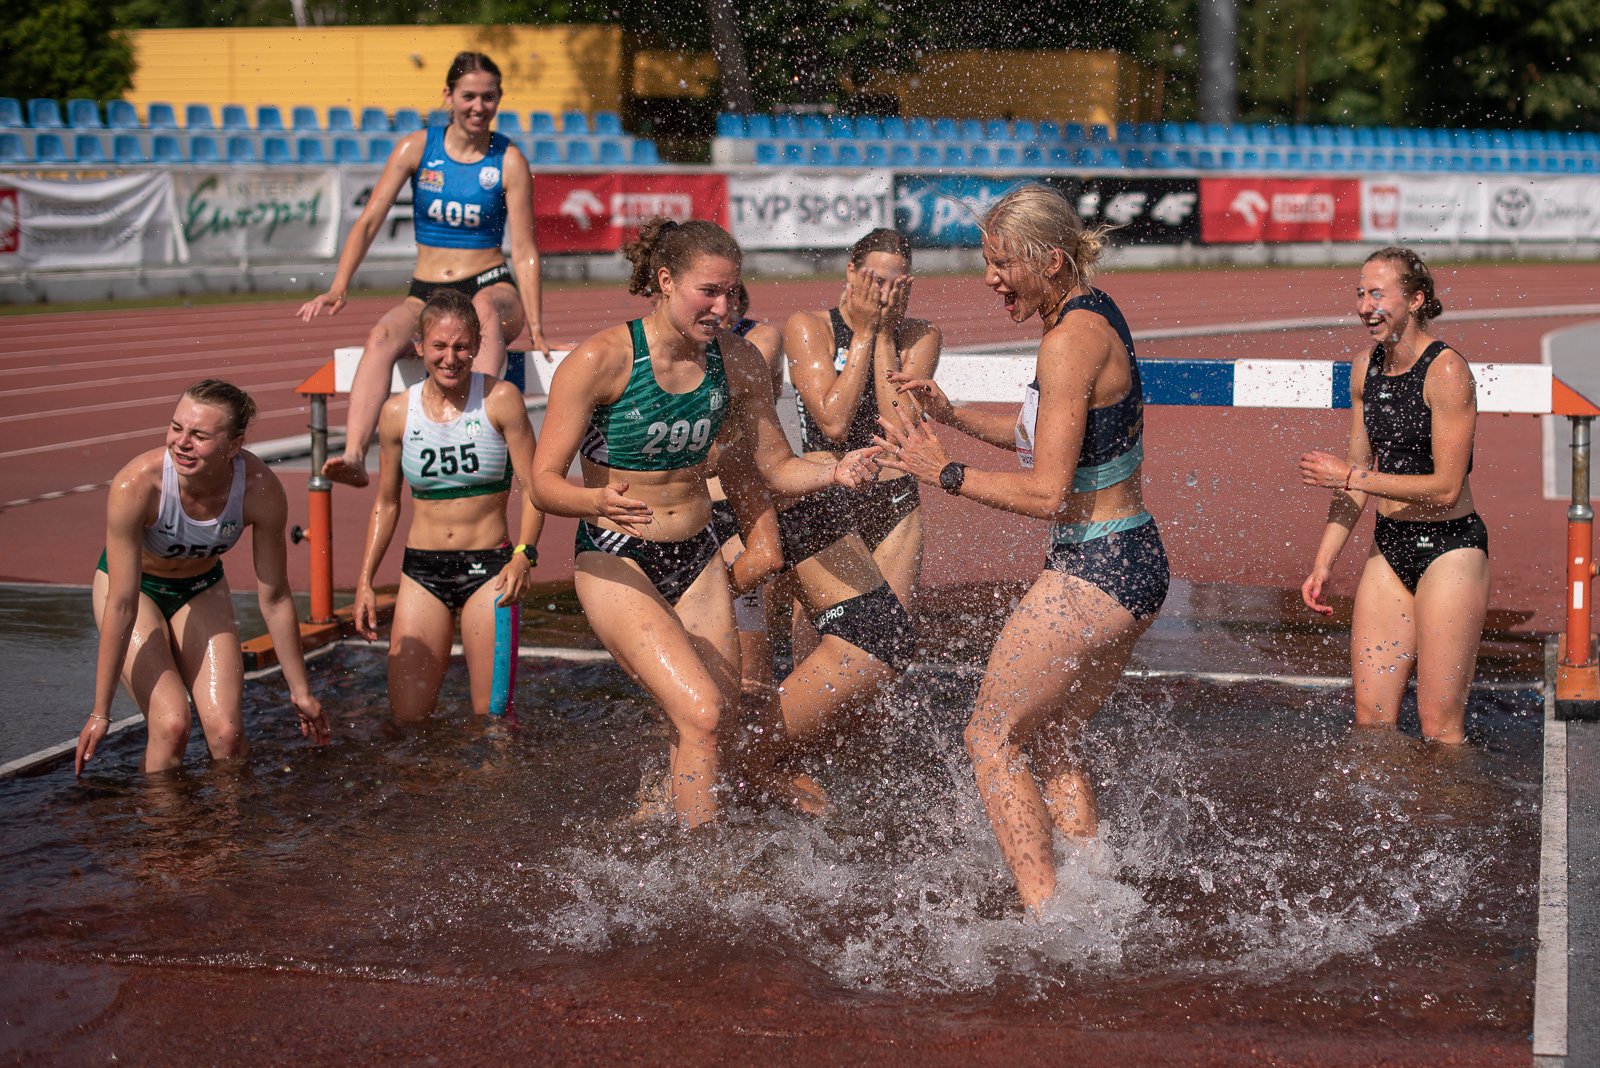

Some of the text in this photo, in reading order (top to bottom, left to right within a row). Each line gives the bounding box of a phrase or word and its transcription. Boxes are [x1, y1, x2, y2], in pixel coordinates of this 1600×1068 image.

[428, 198, 481, 227] 405
[730, 193, 887, 223] TVP SPORT
[1103, 191, 1148, 224] 4F
[1150, 191, 1198, 225] 4F
[477, 267, 500, 285] NIKE
[641, 418, 711, 454] 299
[420, 442, 480, 478] 255
